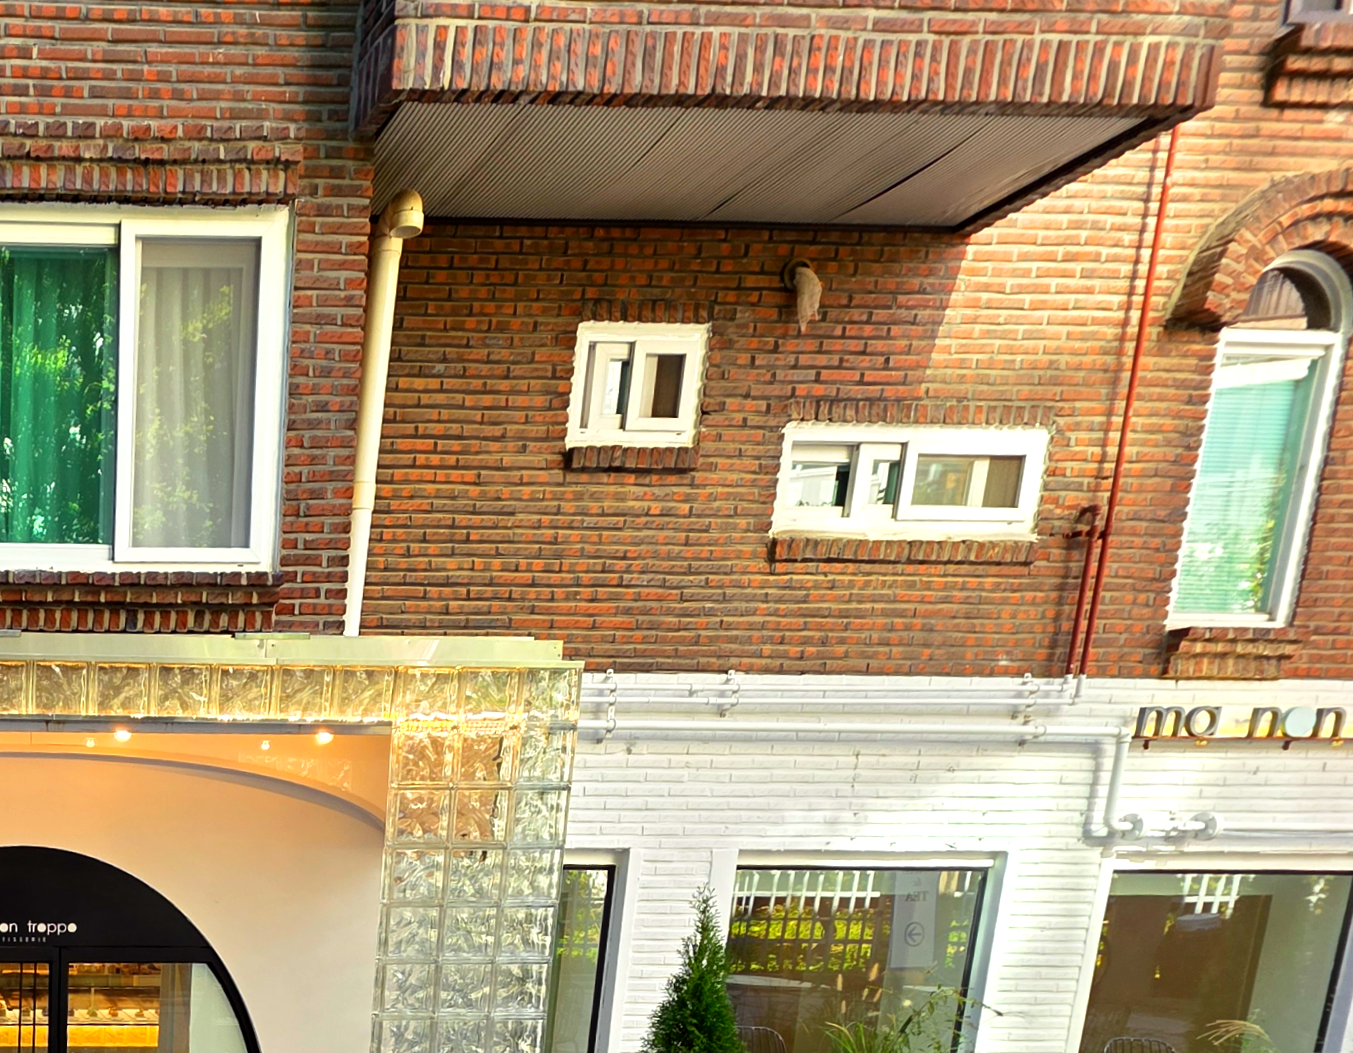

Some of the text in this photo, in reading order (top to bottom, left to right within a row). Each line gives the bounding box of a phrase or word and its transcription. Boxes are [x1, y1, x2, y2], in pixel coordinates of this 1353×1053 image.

[1135, 706, 1347, 737] ma non
[27, 919, 77, 935] troppo
